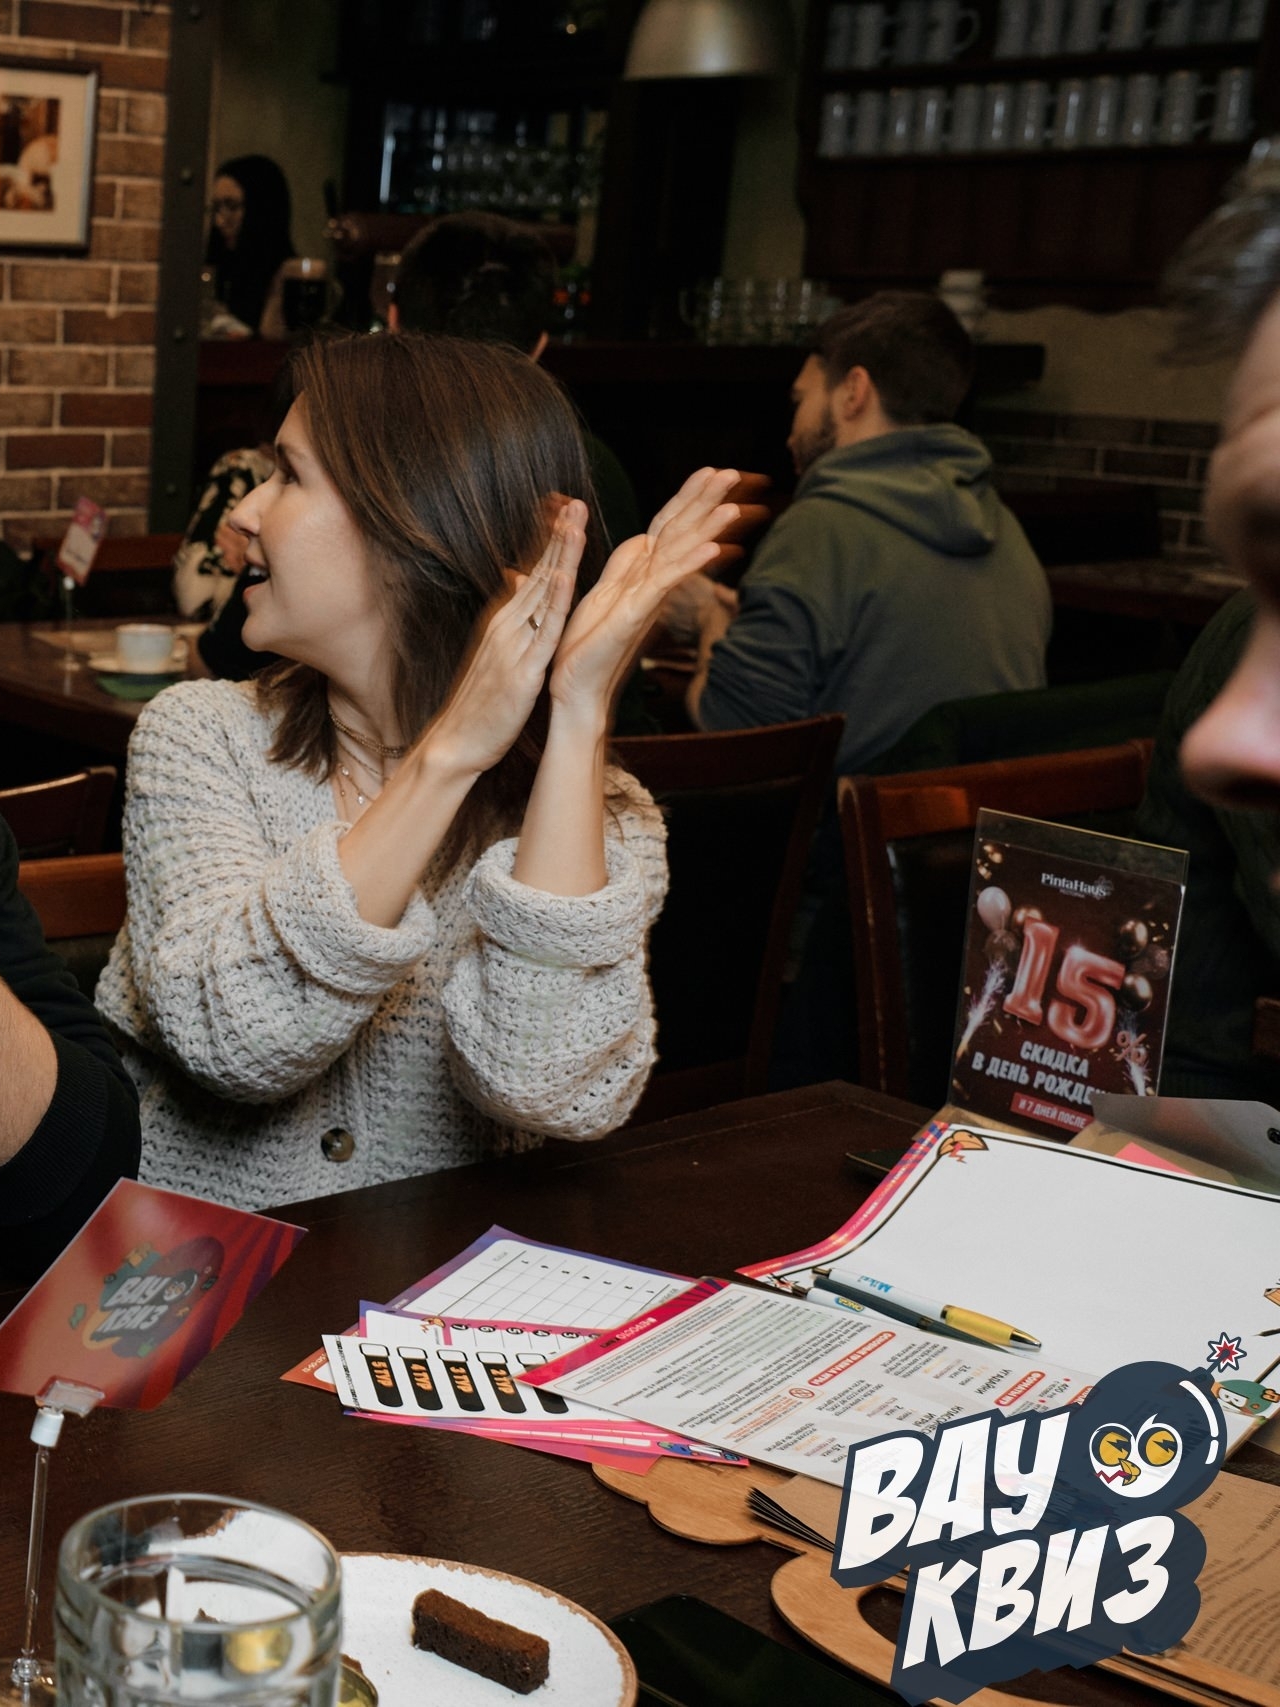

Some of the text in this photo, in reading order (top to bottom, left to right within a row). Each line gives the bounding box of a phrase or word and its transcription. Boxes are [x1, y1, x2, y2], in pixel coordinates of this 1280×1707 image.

[1041, 871, 1107, 898] PintaHaus
[1002, 917, 1126, 1049] 15
[1020, 1040, 1089, 1078] СКИДКА
[972, 1051, 1111, 1106] В ДЕНЬ РОЖДЕ
[1026, 1101, 1034, 1111] 7
[1033, 1103, 1057, 1120] ДНЕЙ
[1057, 1110, 1088, 1128] ПОСЛЕ
[104, 1275, 171, 1307] ВАУ
[96, 1305, 169, 1333] КВИЗ
